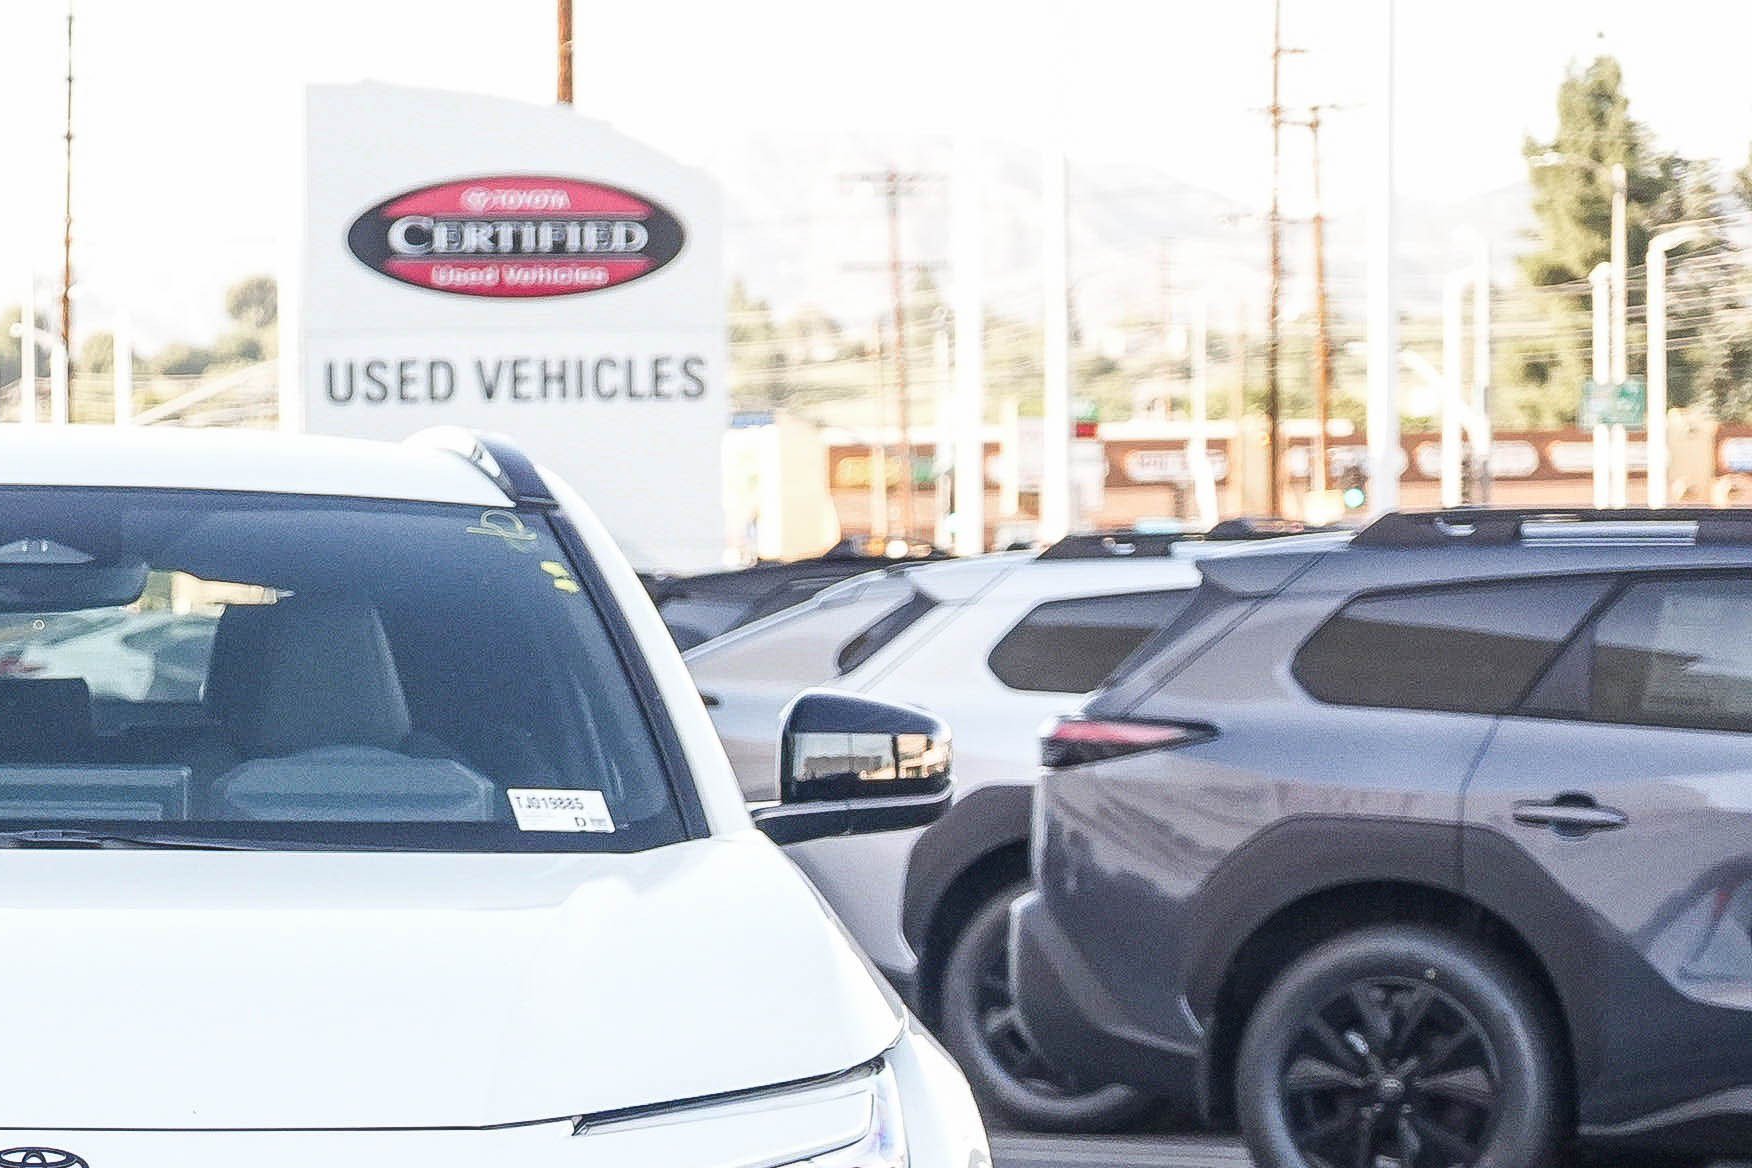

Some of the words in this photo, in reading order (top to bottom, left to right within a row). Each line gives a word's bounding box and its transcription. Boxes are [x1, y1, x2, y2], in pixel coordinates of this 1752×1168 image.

[388, 215, 649, 254] CERTIFIED
[325, 359, 456, 403] USED
[477, 356, 707, 400] VEHICLES
